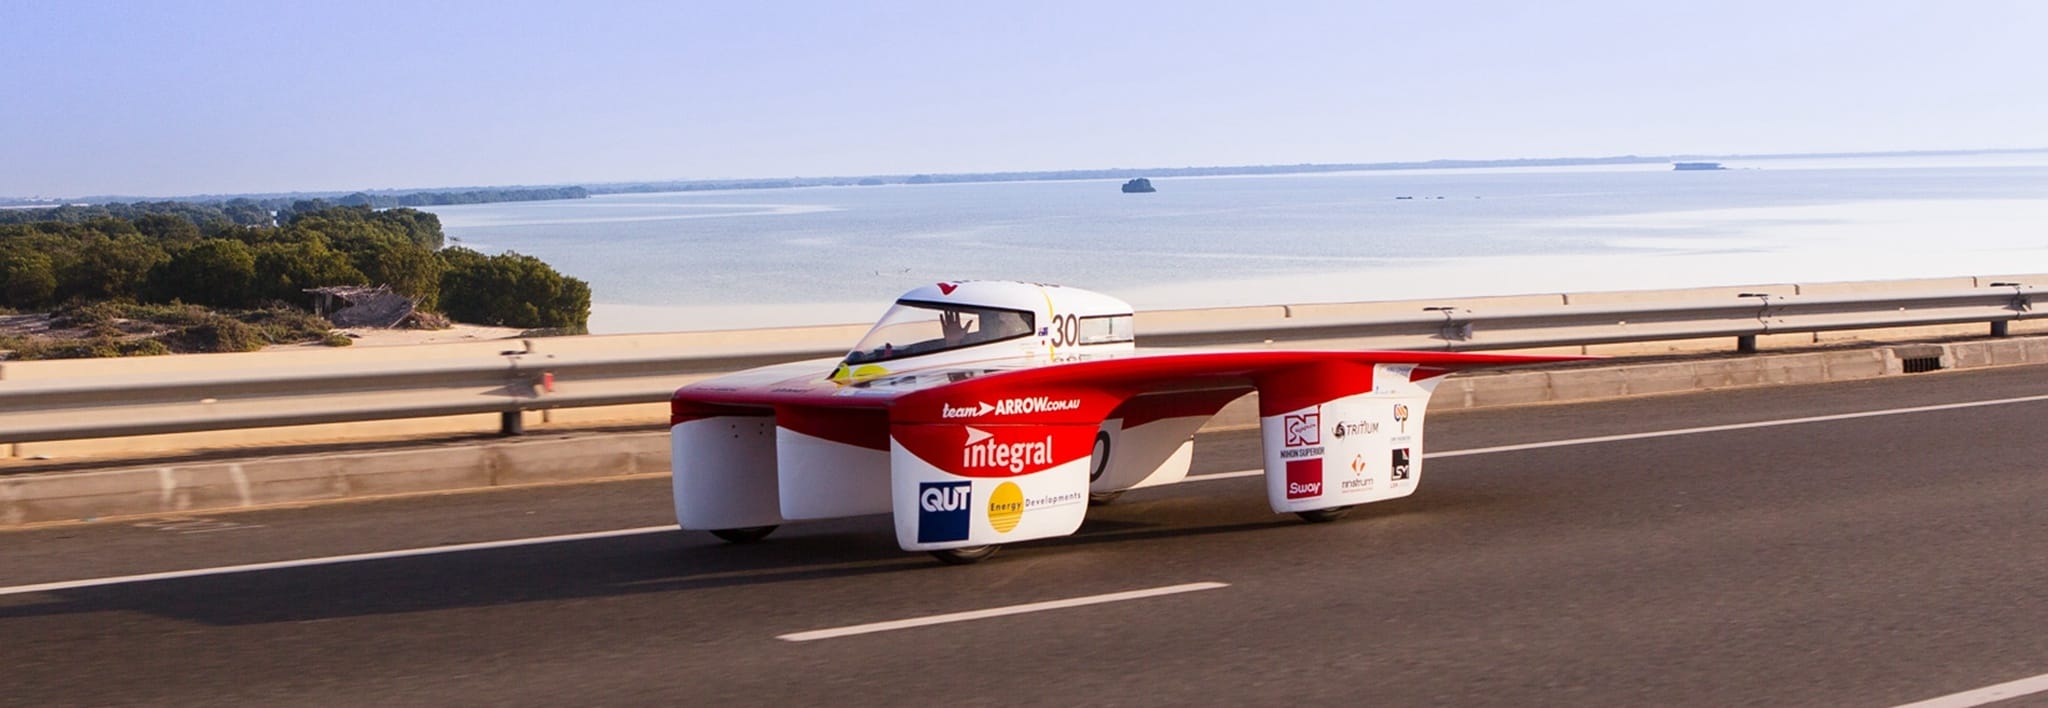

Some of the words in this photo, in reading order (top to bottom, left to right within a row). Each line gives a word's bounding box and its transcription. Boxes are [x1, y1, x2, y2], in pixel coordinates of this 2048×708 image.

[1051, 313, 1078, 348] 30
[943, 403, 980, 418] team
[963, 435, 1053, 473] integral
[921, 486, 971, 512] QUT
[991, 502, 1021, 512] Energy
[1025, 492, 1081, 507] Developments
